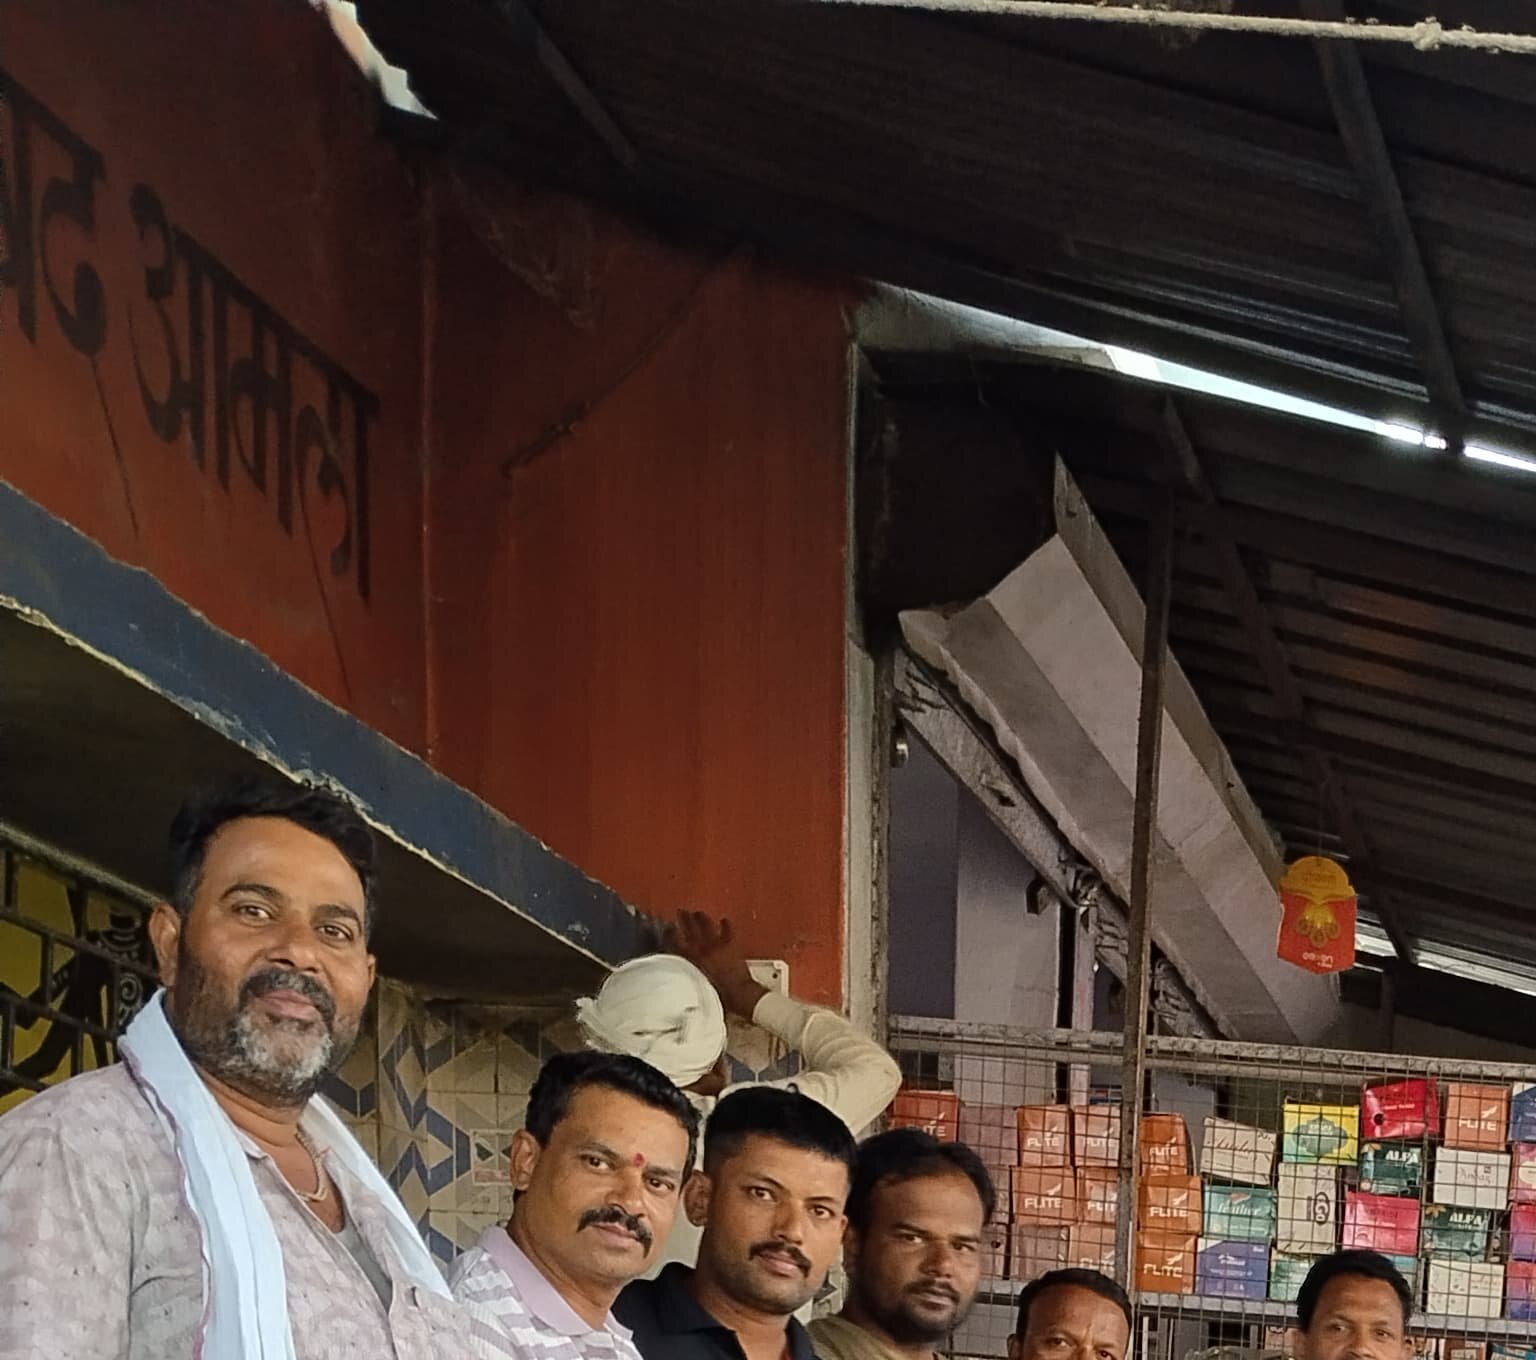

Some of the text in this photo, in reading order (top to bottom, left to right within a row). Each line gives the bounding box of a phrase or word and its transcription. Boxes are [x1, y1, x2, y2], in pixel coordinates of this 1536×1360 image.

[1024, 1197, 1063, 1209] FLITE
[1149, 1205, 1189, 1218] FLITE
[1449, 1211, 1483, 1226] ALFA
